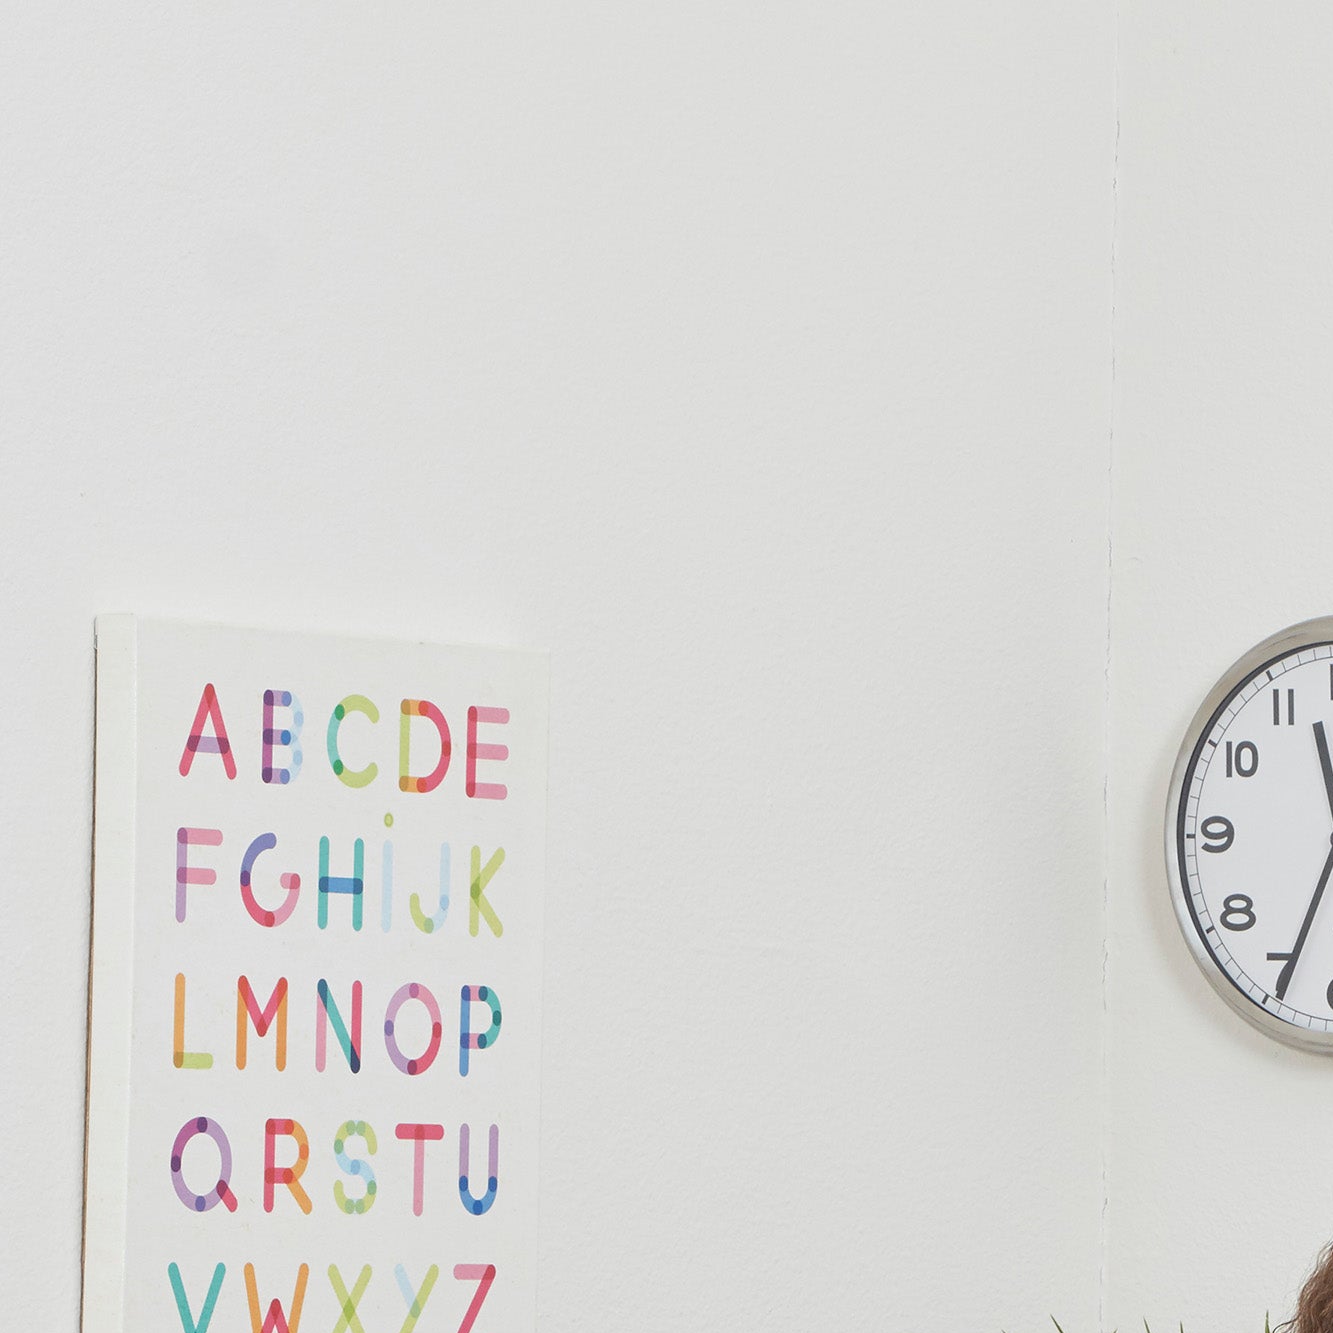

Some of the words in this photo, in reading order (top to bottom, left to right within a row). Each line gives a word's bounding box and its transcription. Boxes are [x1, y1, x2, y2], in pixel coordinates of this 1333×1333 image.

[1272, 688, 1295, 726] 11
[1225, 740, 1259, 778] 10
[1200, 815, 1235, 854] 9
[1219, 893, 1257, 932] 8
